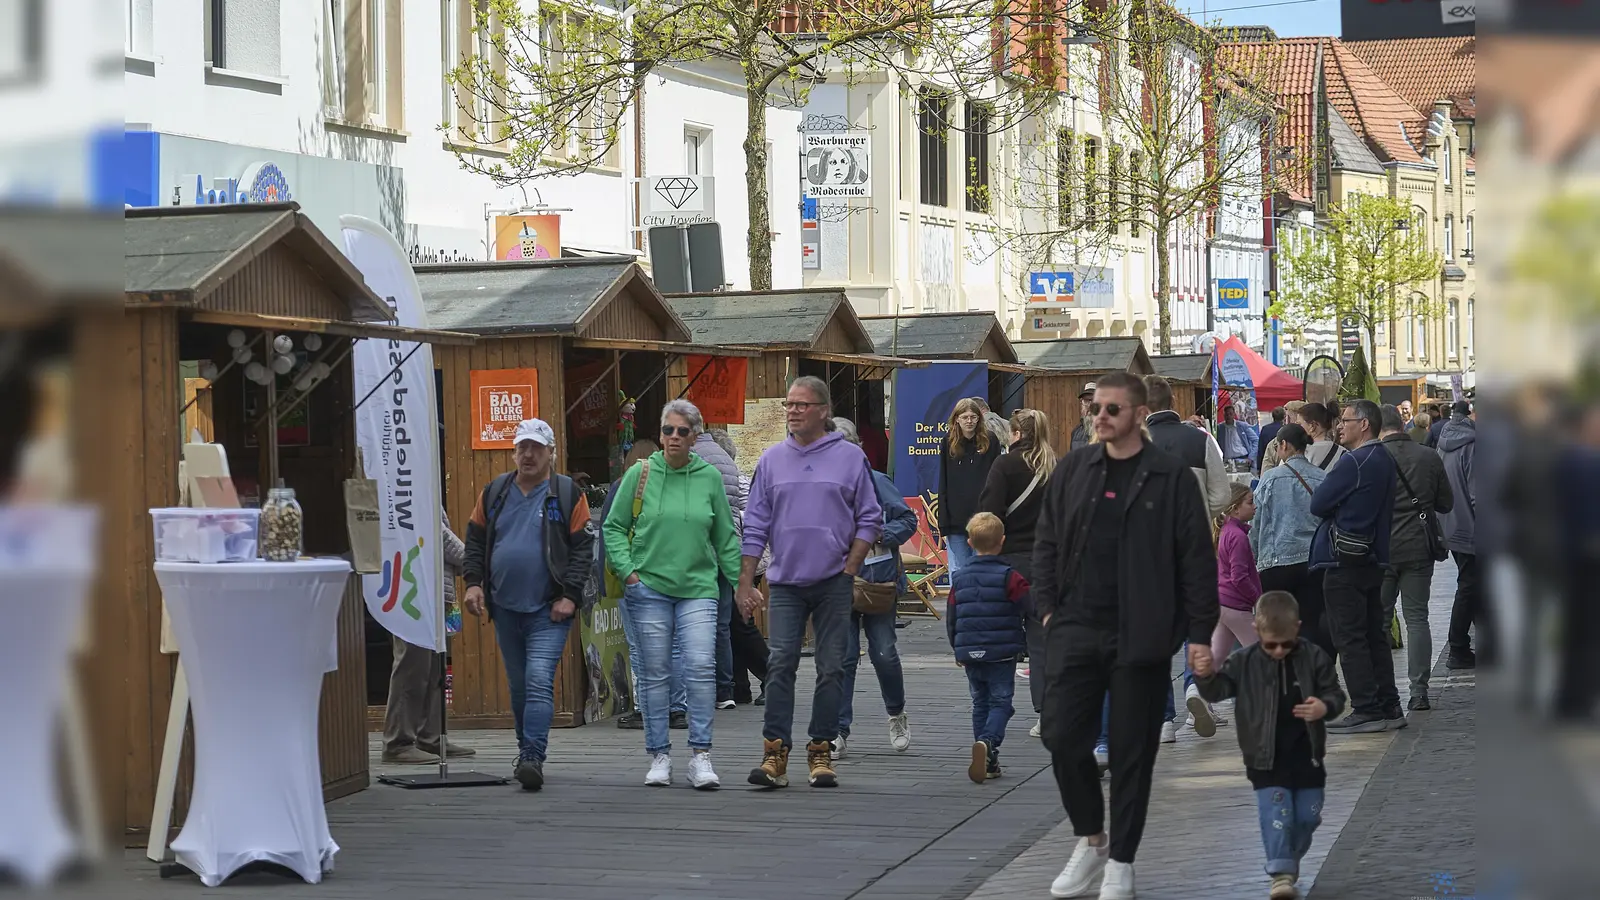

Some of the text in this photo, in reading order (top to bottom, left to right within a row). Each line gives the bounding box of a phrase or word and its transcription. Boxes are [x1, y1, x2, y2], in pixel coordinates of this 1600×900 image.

[807, 136, 867, 149] Warburger
[809, 186, 865, 196] Modestube
[642, 215, 666, 226] City
[1218, 287, 1248, 299] TEDi
[489, 393, 523, 407] BAD
[490, 406, 523, 415] IBURG
[490, 414, 523, 422] ERLEBEN
[915, 422, 934, 432] Der
[916, 436, 943, 444] unter
[594, 608, 609, 634] BAD
